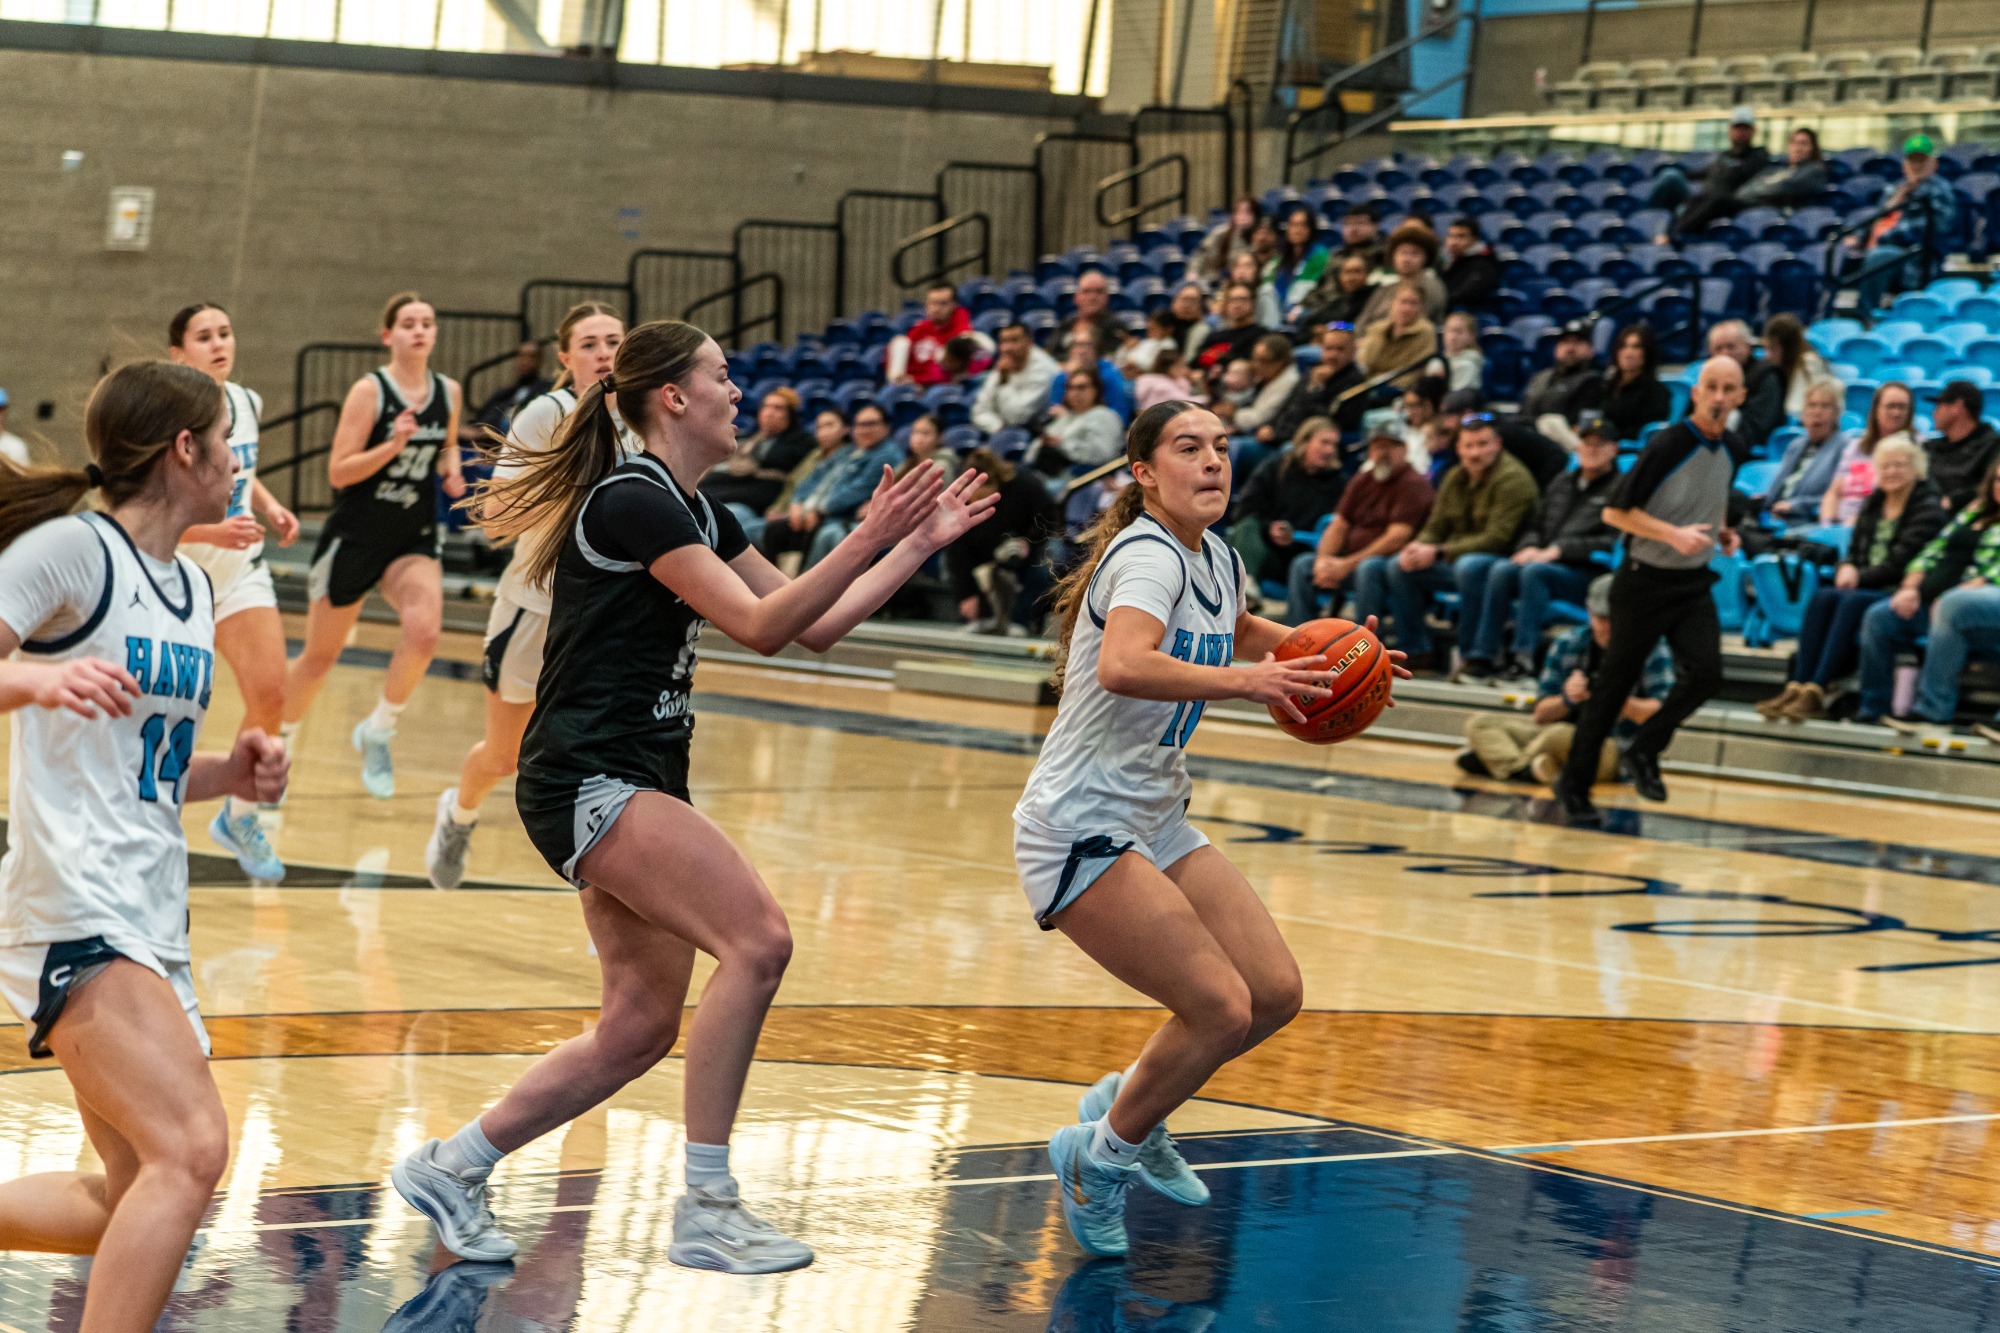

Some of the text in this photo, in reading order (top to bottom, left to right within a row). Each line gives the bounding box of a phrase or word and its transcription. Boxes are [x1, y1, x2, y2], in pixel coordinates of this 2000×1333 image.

[387, 444, 437, 481] 30
[1158, 700, 1206, 749] 11
[138, 712, 195, 804] 14
